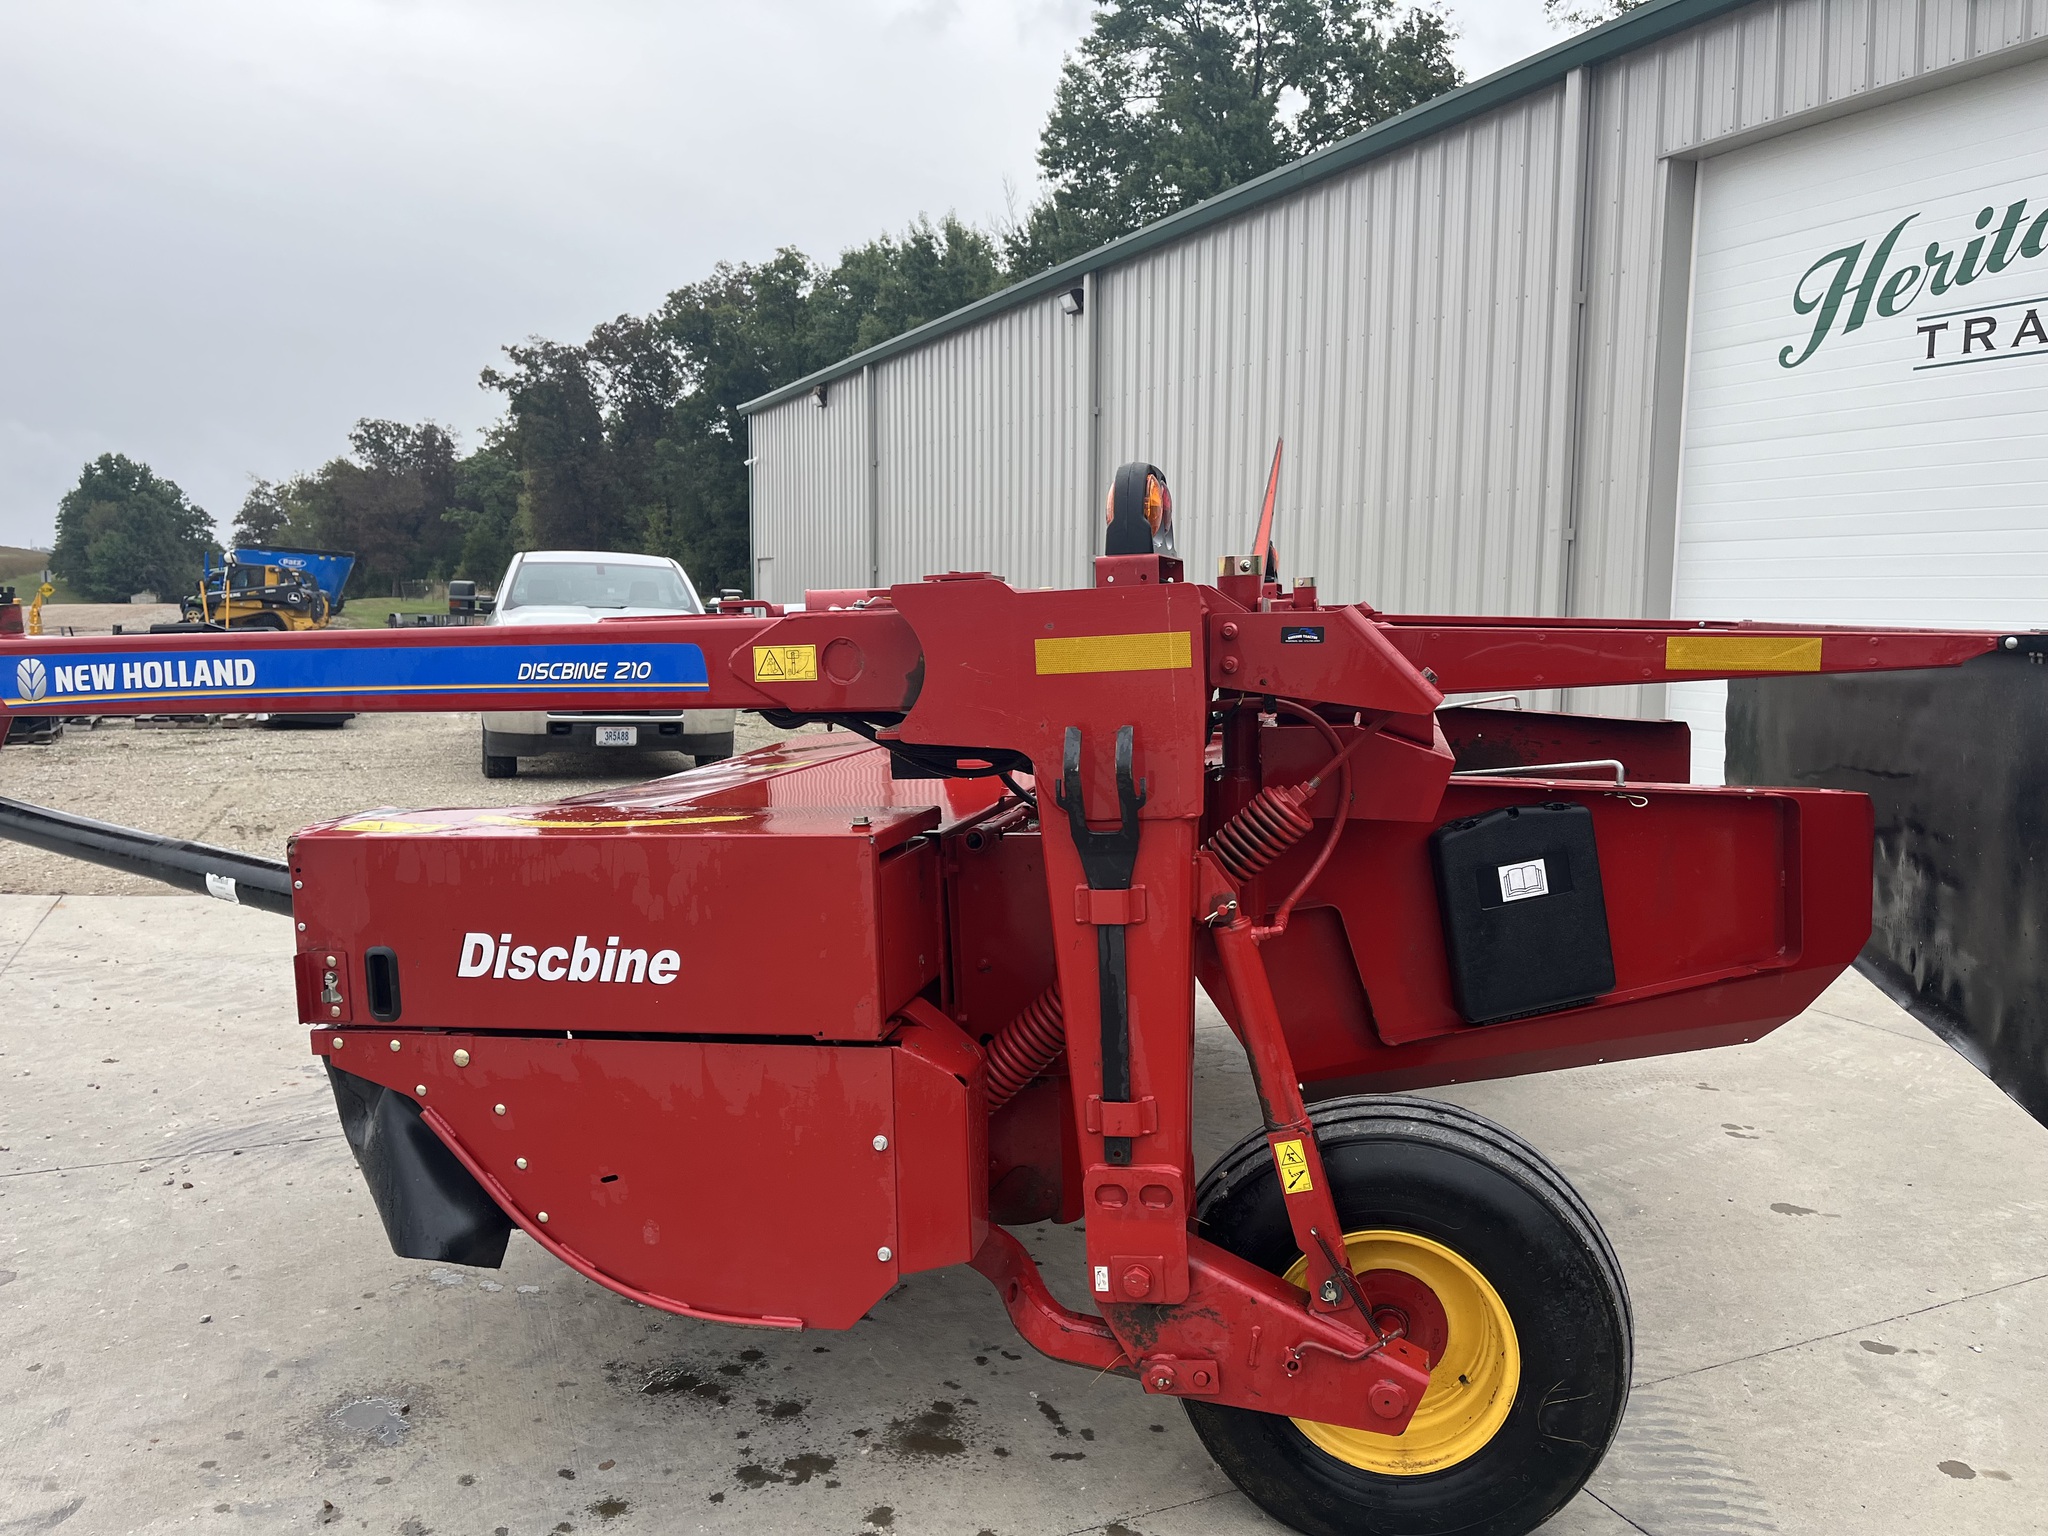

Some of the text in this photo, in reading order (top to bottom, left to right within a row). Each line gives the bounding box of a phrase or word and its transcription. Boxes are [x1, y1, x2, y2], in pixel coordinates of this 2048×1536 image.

[1917, 309, 2048, 359] TRA
[54, 658, 257, 693] NEW HOLLAND
[517, 661, 652, 681] DISCBINE 210
[456, 932, 681, 986] Discbine
